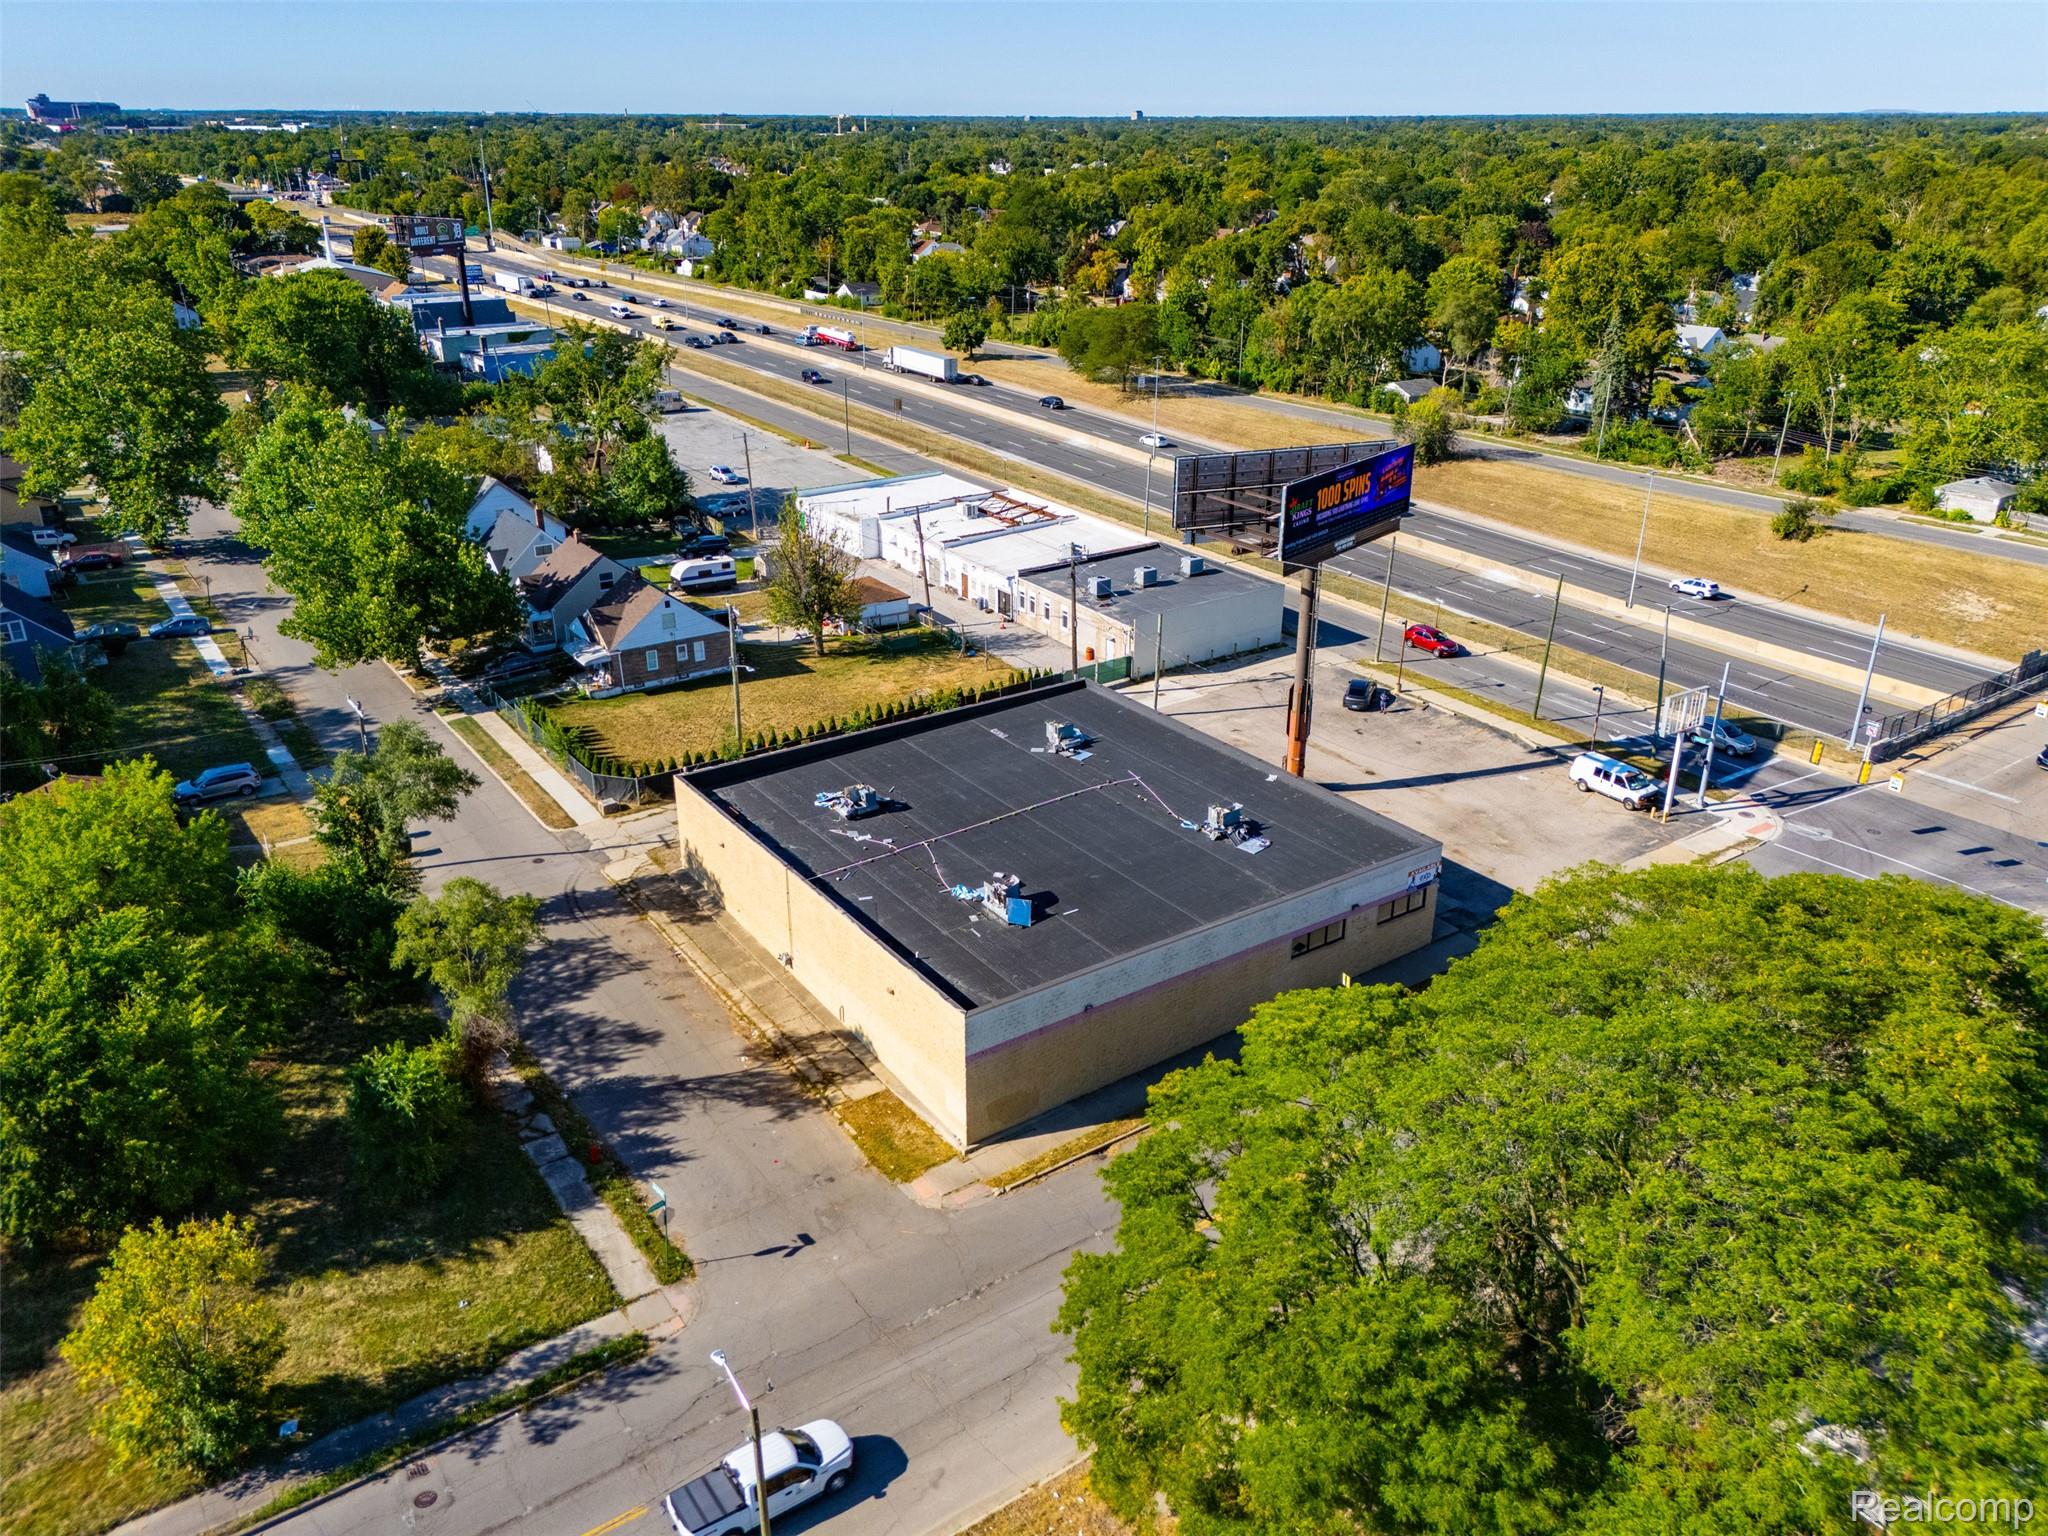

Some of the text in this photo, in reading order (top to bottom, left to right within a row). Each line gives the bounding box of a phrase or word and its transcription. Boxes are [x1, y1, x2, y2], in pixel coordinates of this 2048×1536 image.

[410, 235, 436, 247] DIFFERENT
[1316, 484, 1341, 511] 1000
[1343, 472, 1371, 501] SPINS
[1292, 507, 1312, 521] KINGS
